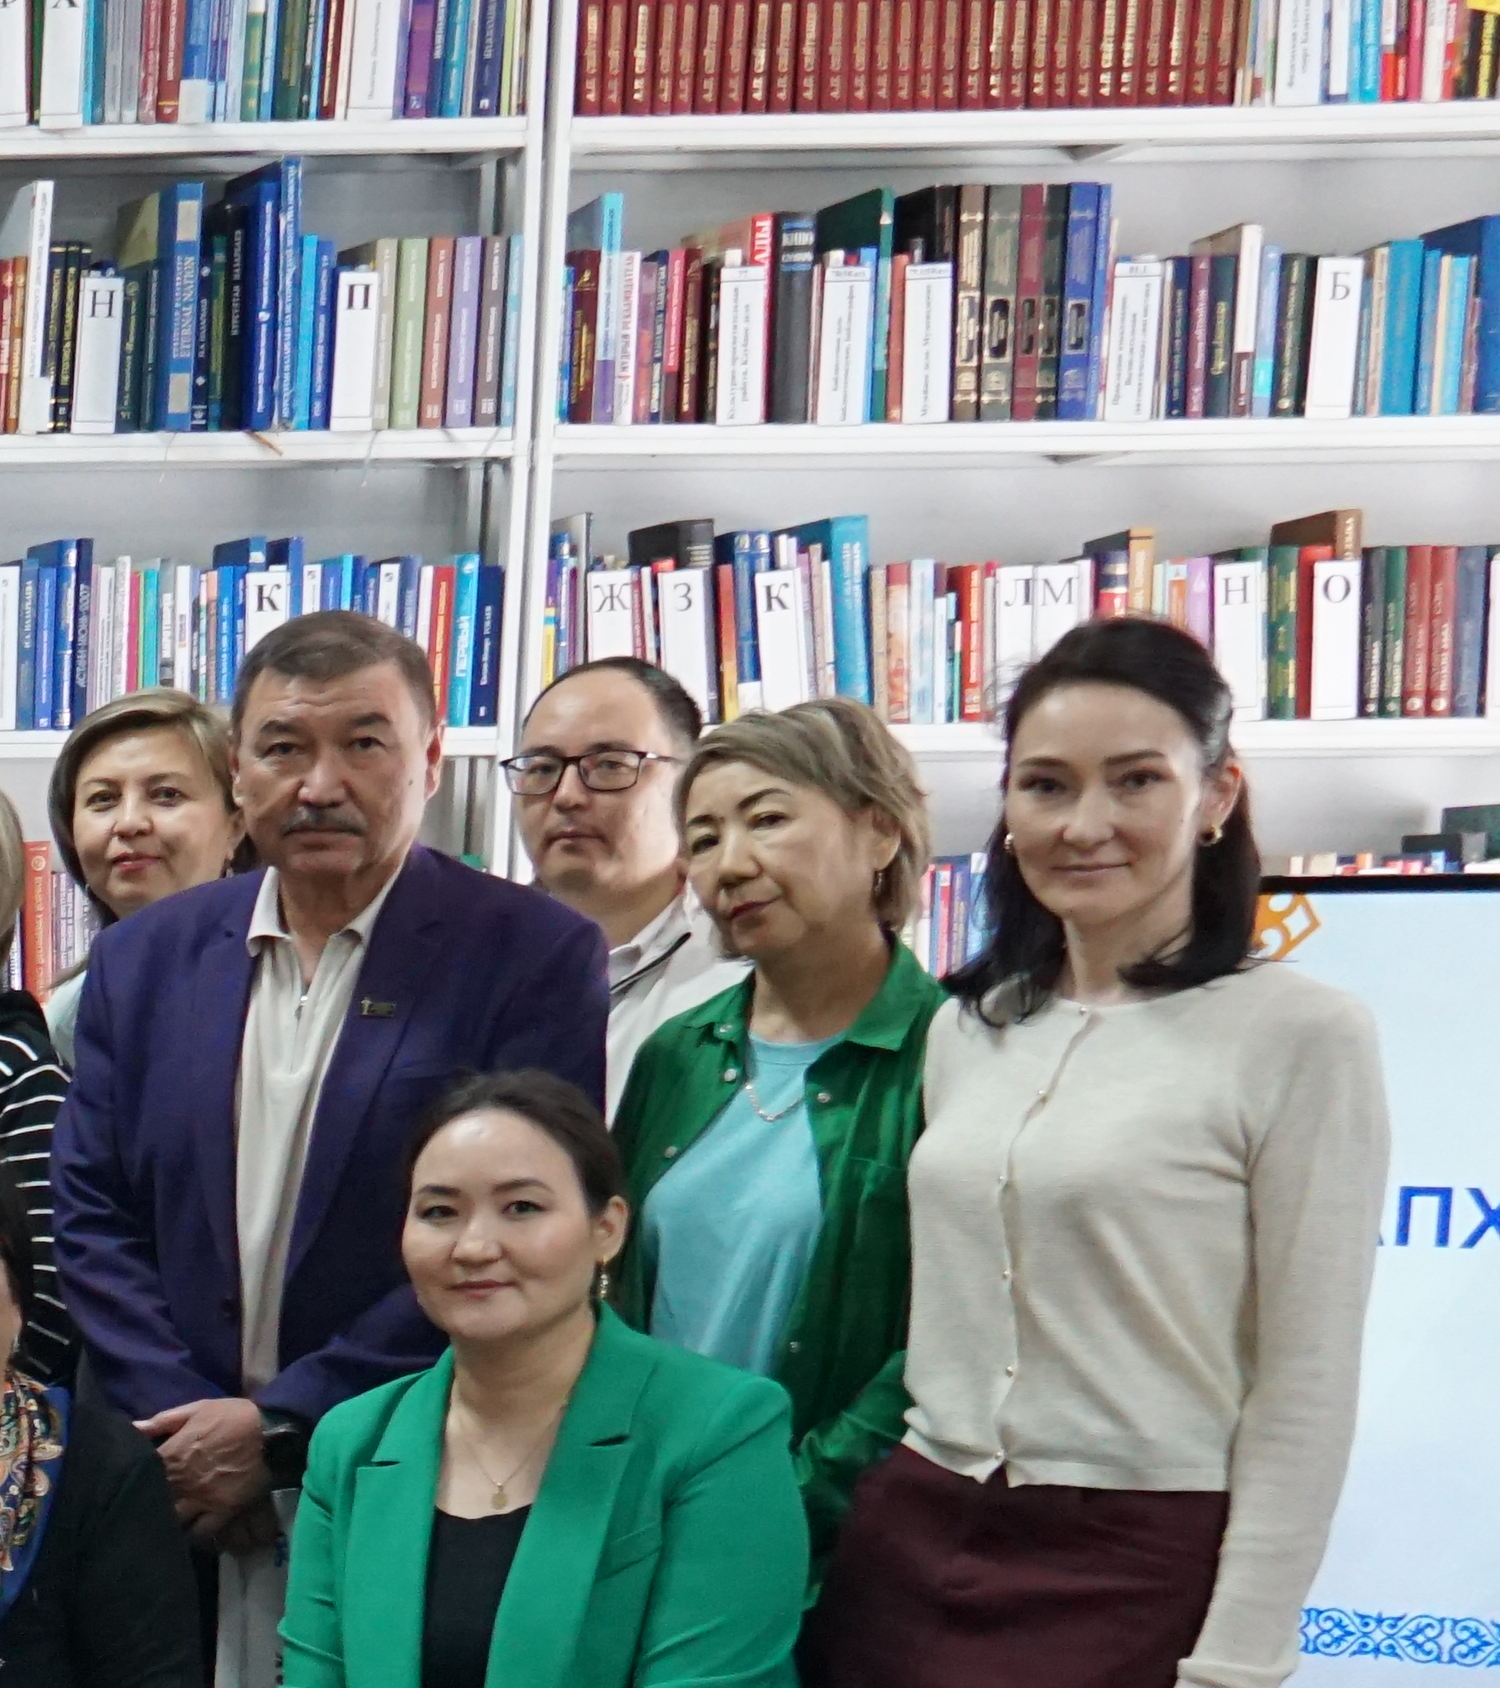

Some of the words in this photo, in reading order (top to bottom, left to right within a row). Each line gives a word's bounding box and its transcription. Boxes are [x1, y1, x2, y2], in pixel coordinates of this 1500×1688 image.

[231, 230, 243, 280] НАЗАРБАЕВ
[182, 256, 197, 300] NATION
[1329, 271, 1350, 301] Б
[88, 289, 116, 319] Н
[231, 287, 241, 336] НУРСУЛТАН
[346, 283, 371, 311] П
[179, 304, 194, 357] ETERNAL
[255, 583, 282, 612] К
[593, 581, 627, 613] Ж
[672, 581, 693, 612] З
[764, 581, 791, 612] К
[1004, 578, 1034, 607] Л
[1045, 576, 1078, 607] М
[1221, 575, 1251, 605] Н
[1323, 573, 1351, 604] О
[455, 616, 468, 677] ПЕРВЫЙ
[1377, 1187, 1500, 1250] ПХ
